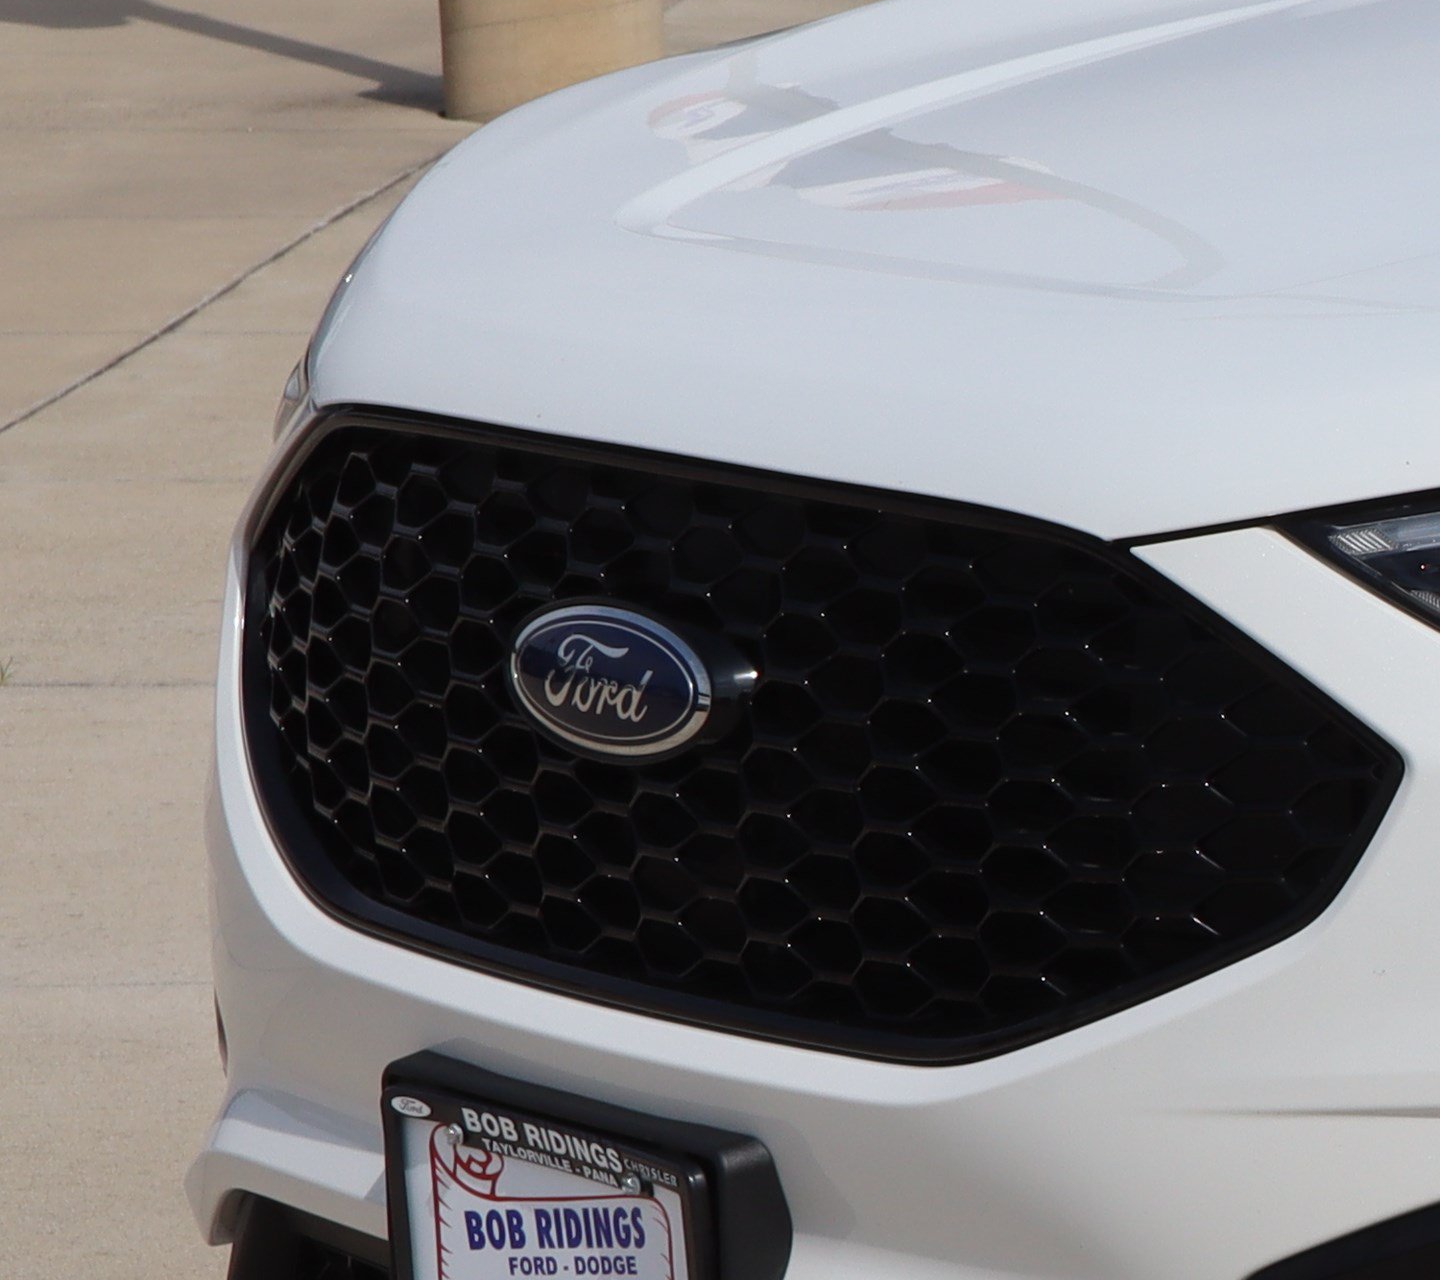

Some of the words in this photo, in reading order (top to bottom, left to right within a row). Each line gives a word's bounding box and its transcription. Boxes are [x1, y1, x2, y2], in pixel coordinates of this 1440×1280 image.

[543, 632, 652, 724] Ford
[398, 1096, 424, 1116] Ford
[461, 1106, 520, 1144] BOB
[522, 1120, 624, 1174] RIDINGS
[481, 1137, 572, 1173] TAYLORVILLE
[582, 1165, 619, 1188] PANA
[622, 1157, 678, 1188] CHRYSLER
[464, 1208, 527, 1251] BOB
[534, 1206, 646, 1250] RIDINGS
[508, 1256, 558, 1277] FORD
[574, 1255, 639, 1276] DODGE
